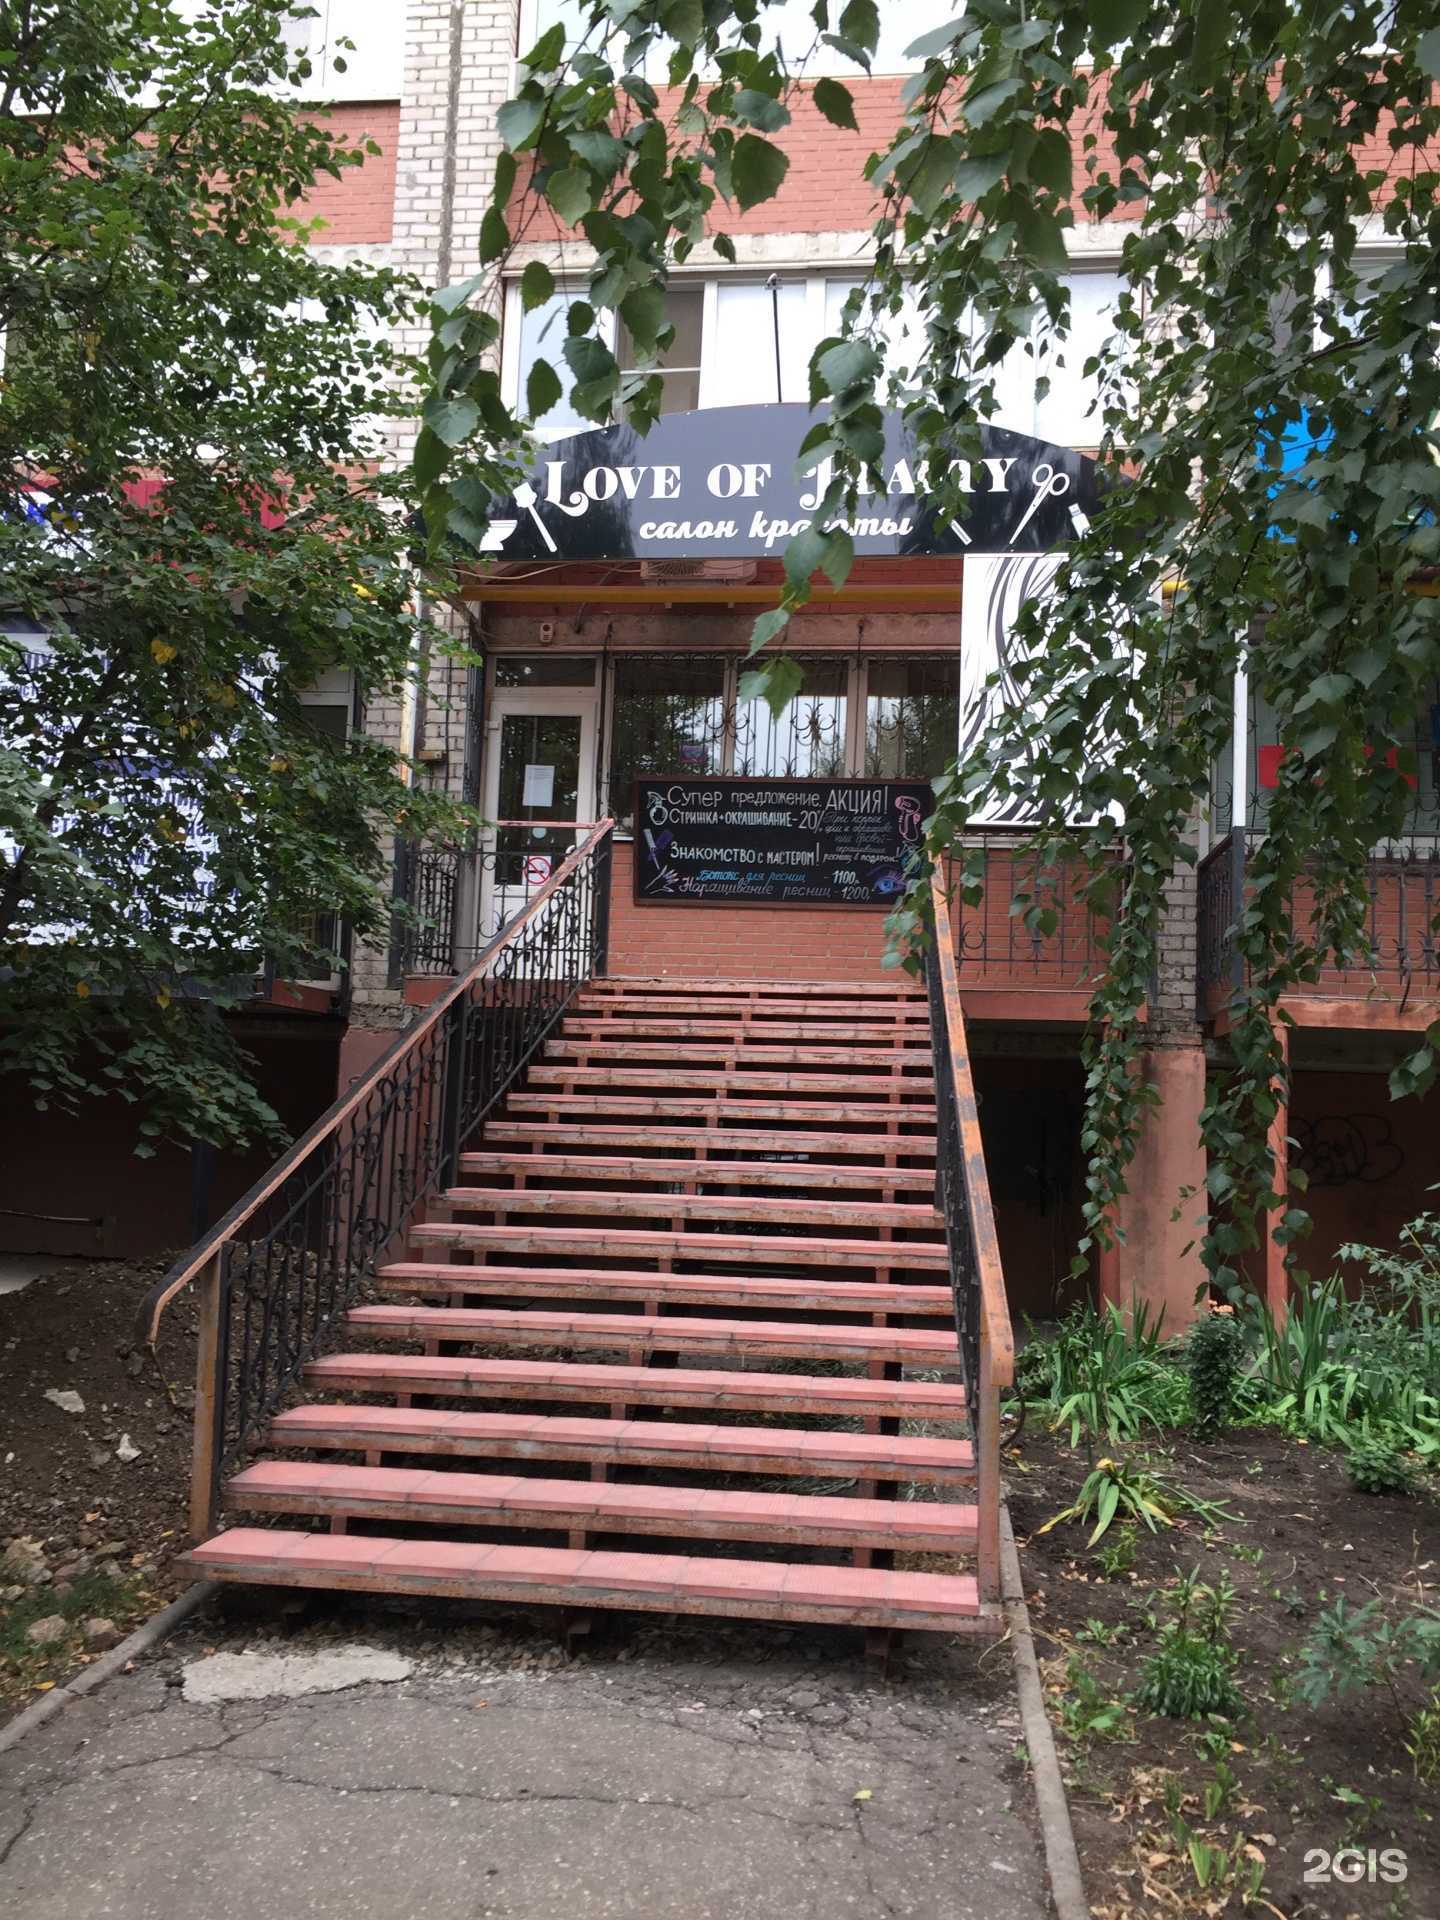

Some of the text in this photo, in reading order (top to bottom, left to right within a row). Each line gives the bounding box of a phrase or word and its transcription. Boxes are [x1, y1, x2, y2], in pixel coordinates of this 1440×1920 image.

[543, 461, 682, 517] LOVE
[706, 463, 772, 498] OF
[639, 518, 739, 540] салон
[667, 786, 723, 808] Супер
[825, 786, 888, 814] АКЦИЯ!
